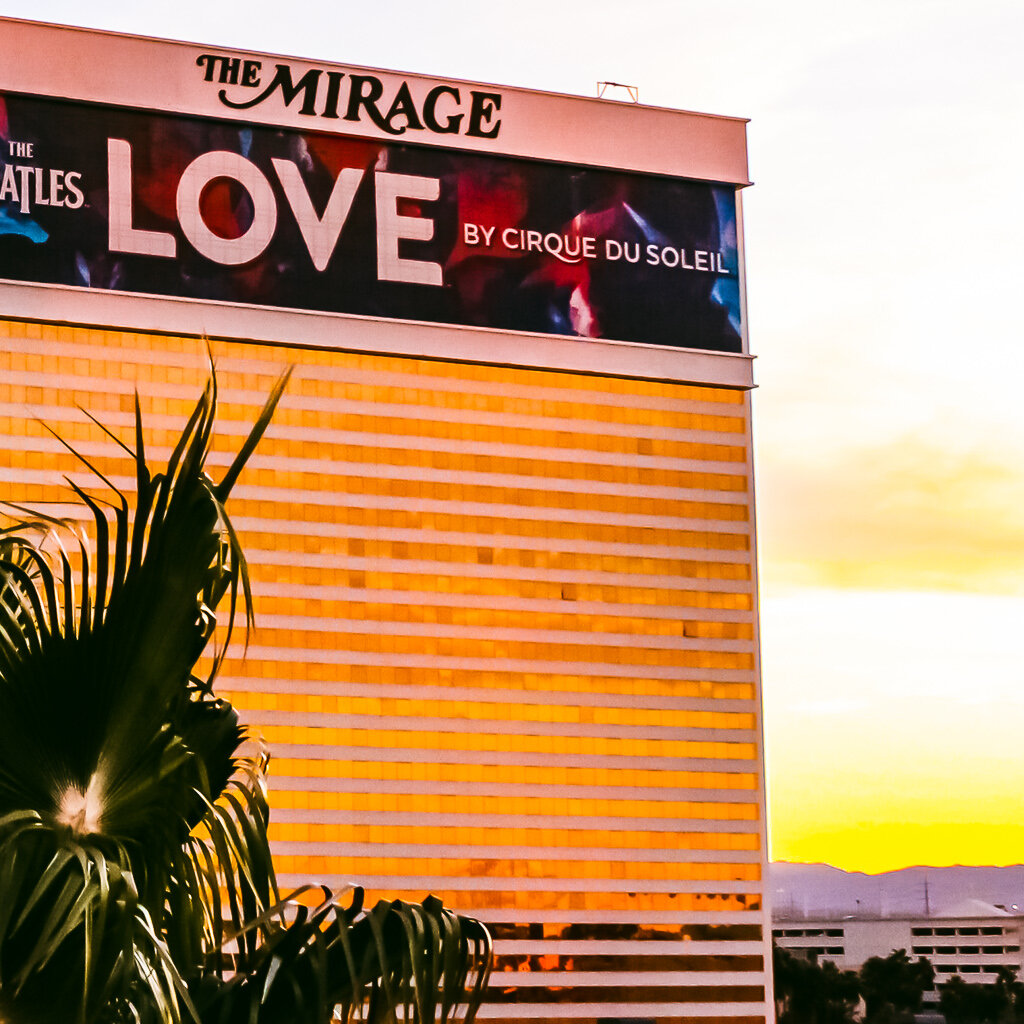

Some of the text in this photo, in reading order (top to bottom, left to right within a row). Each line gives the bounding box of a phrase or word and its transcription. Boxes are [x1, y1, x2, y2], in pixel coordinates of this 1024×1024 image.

[196, 54, 503, 139] THE MIRAGE
[8, 140, 34, 158] THE
[107, 138, 444, 286] LOVE
[463, 223, 730, 274] BY CIRQUE DU SOLEIL
